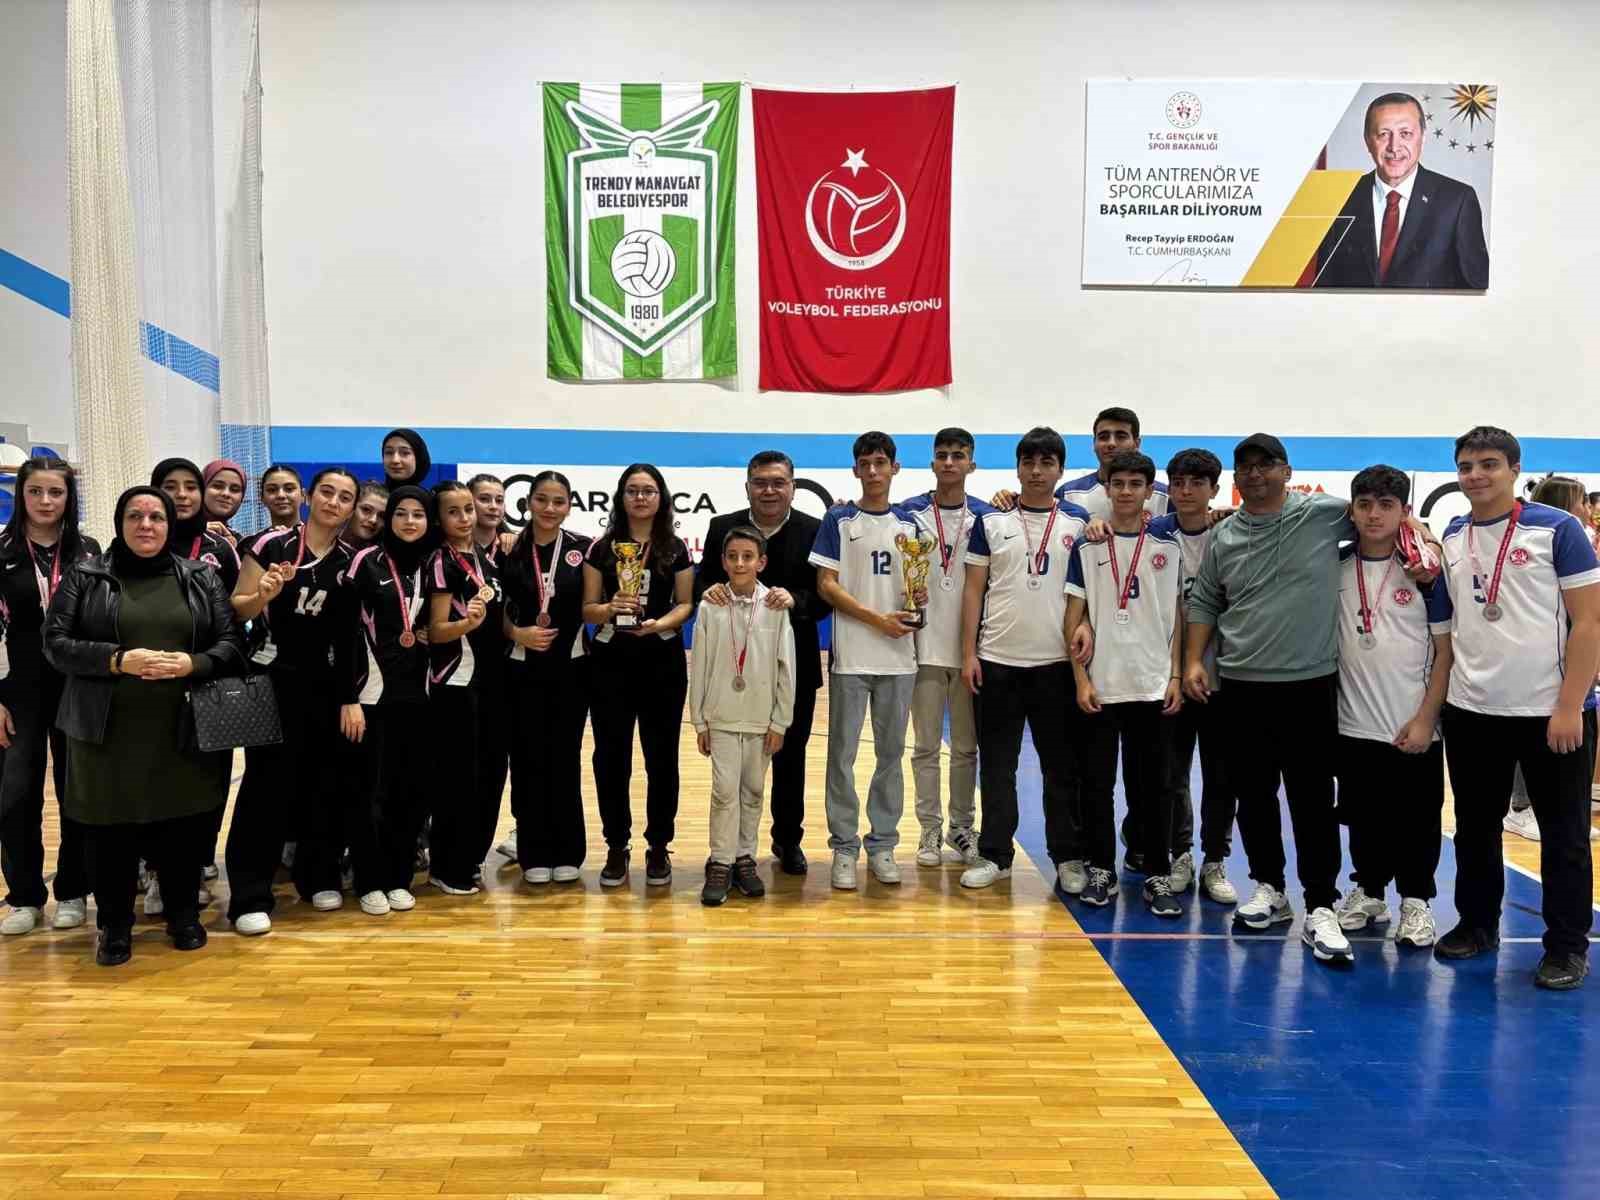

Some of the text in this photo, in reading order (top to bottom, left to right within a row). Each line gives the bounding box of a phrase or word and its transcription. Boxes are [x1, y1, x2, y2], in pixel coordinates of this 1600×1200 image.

[1166, 131, 1204, 142] GENÇLİK
[1207, 132, 1218, 141] VE
[1148, 141, 1218, 151] SPOR BAKANLIĞI
[1104, 164, 1260, 182] TÜM ANTRENÖR VE
[585, 175, 701, 191] TRENDY MANAVGAT
[1109, 184, 1254, 200] SPORCULARIMIZA
[1100, 202, 1262, 218] BAŞARILAR DİLİYORUM
[1125, 233, 1234, 245] Recep Tayyip ERDOĞAN
[1146, 246, 1231, 259] CUMHURBAŞKANI
[825, 284, 887, 300] TÜRKİYE
[631, 304, 659, 320] 1980
[767, 297, 943, 317] VOLEYBOL FEDERASYONU
[871, 550, 892, 575] 12
[294, 586, 328, 617] 14
